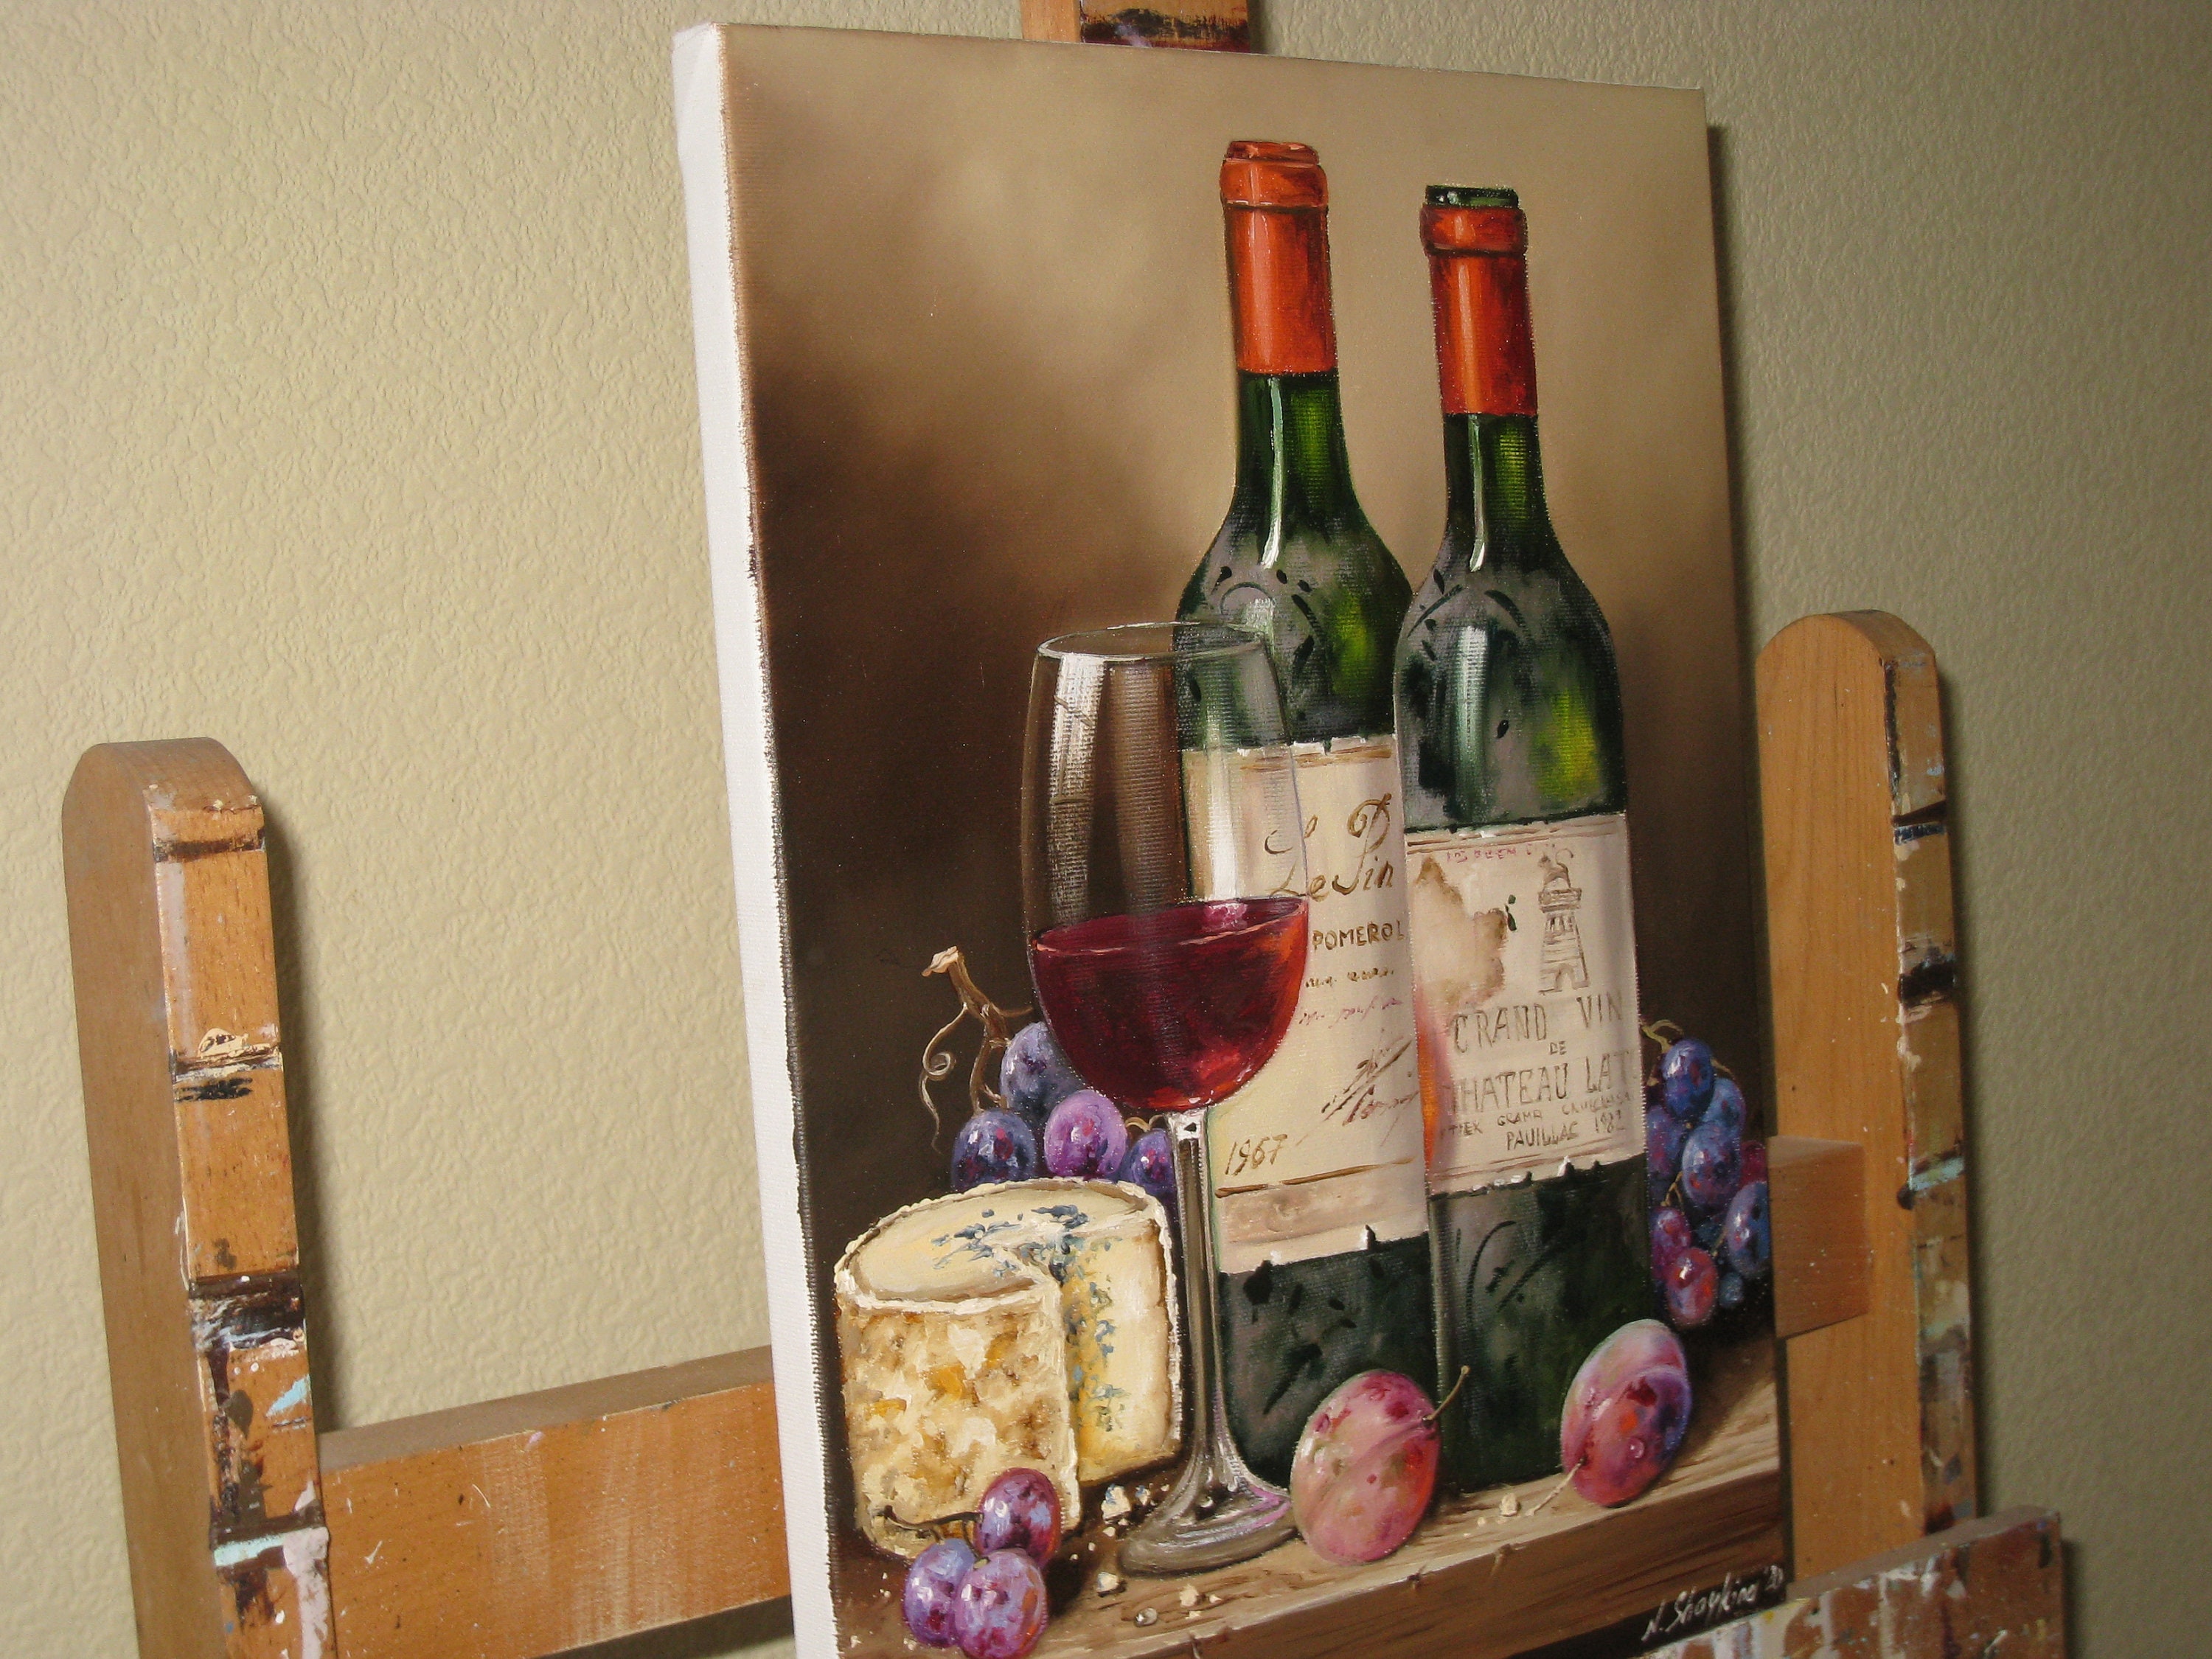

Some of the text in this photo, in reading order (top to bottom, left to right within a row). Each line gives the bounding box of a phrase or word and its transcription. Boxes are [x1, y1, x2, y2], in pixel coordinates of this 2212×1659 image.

[1575, 992, 1623, 1028] VIN
[1549, 1040, 1566, 1055] DE
[1224, 1133, 1288, 1176] 1967
